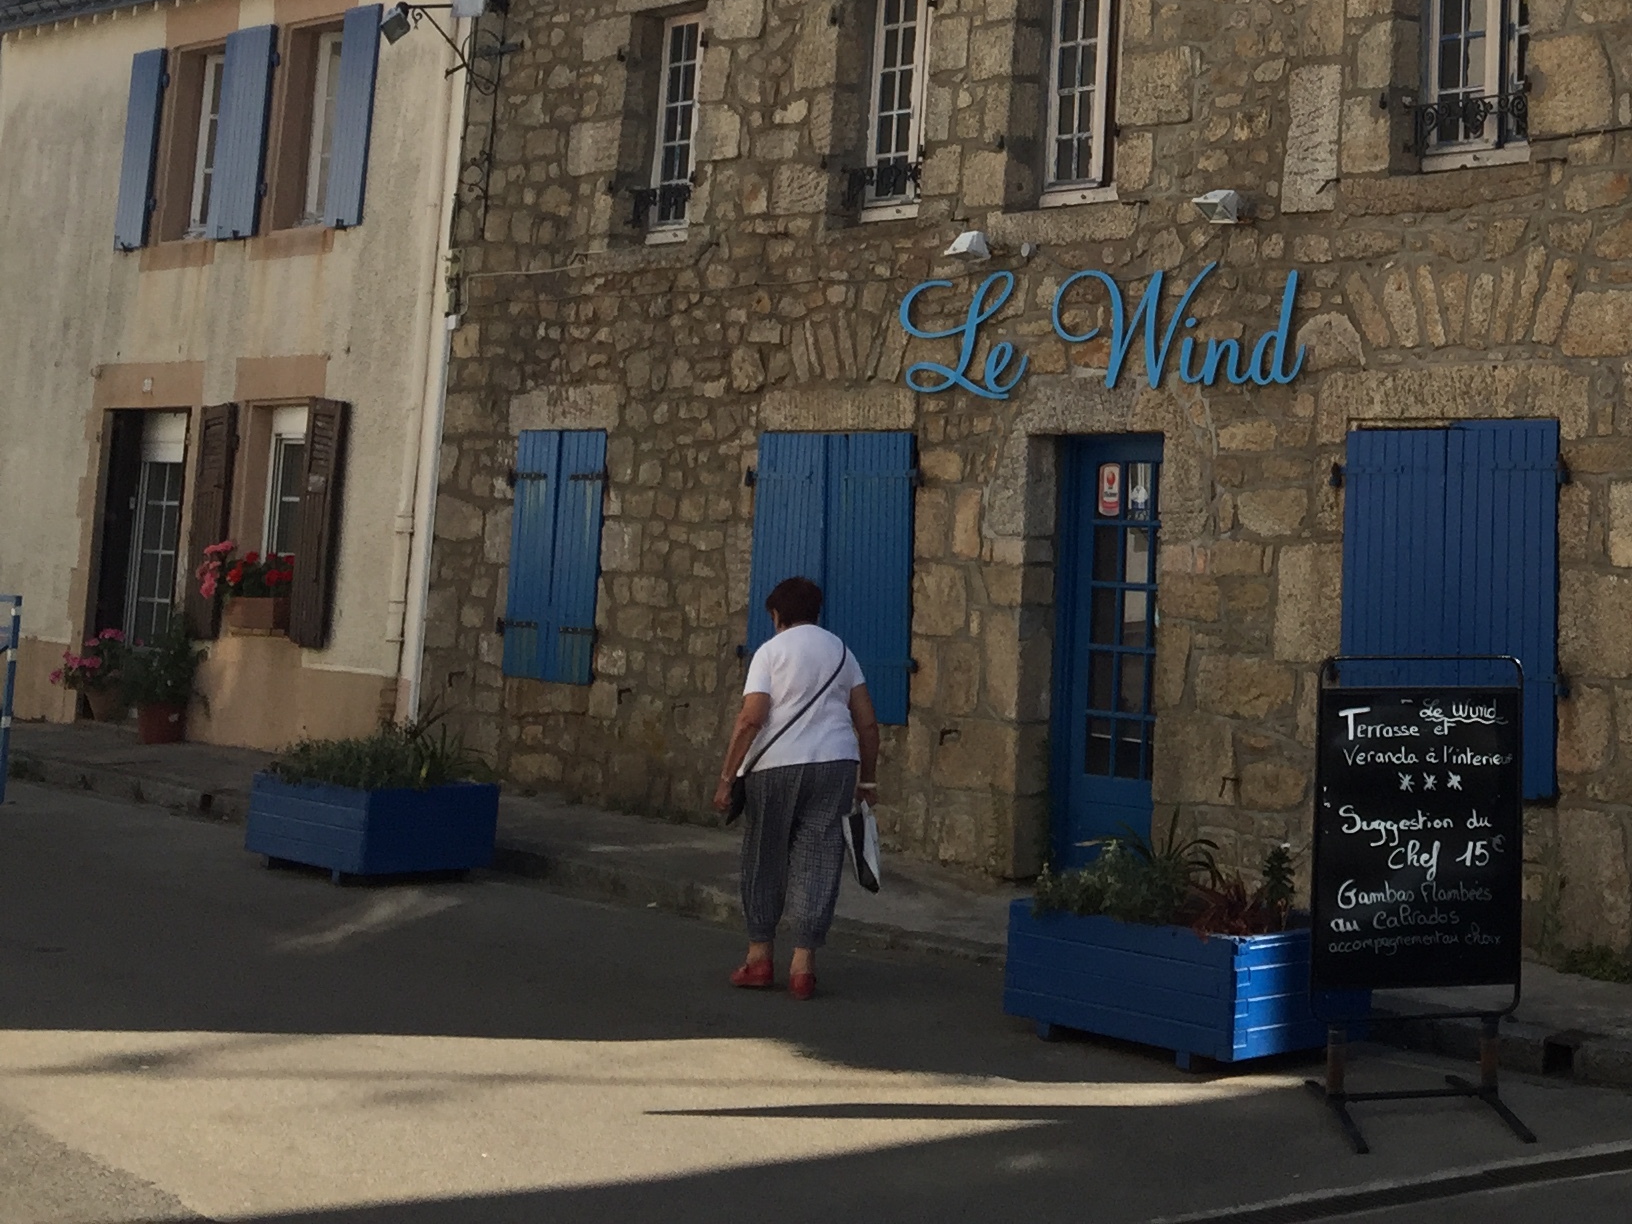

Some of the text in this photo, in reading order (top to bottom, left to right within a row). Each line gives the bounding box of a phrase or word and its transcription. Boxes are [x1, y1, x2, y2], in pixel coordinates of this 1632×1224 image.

[899, 261, 1305, 399] Le Wind
[1338, 707, 1456, 740] Terrasse et
[1343, 745, 1419, 766] Veranda
[1338, 804, 1492, 847] Suggestion du
[1337, 878, 1415, 909] Gambas
[1330, 917, 1361, 933] au
